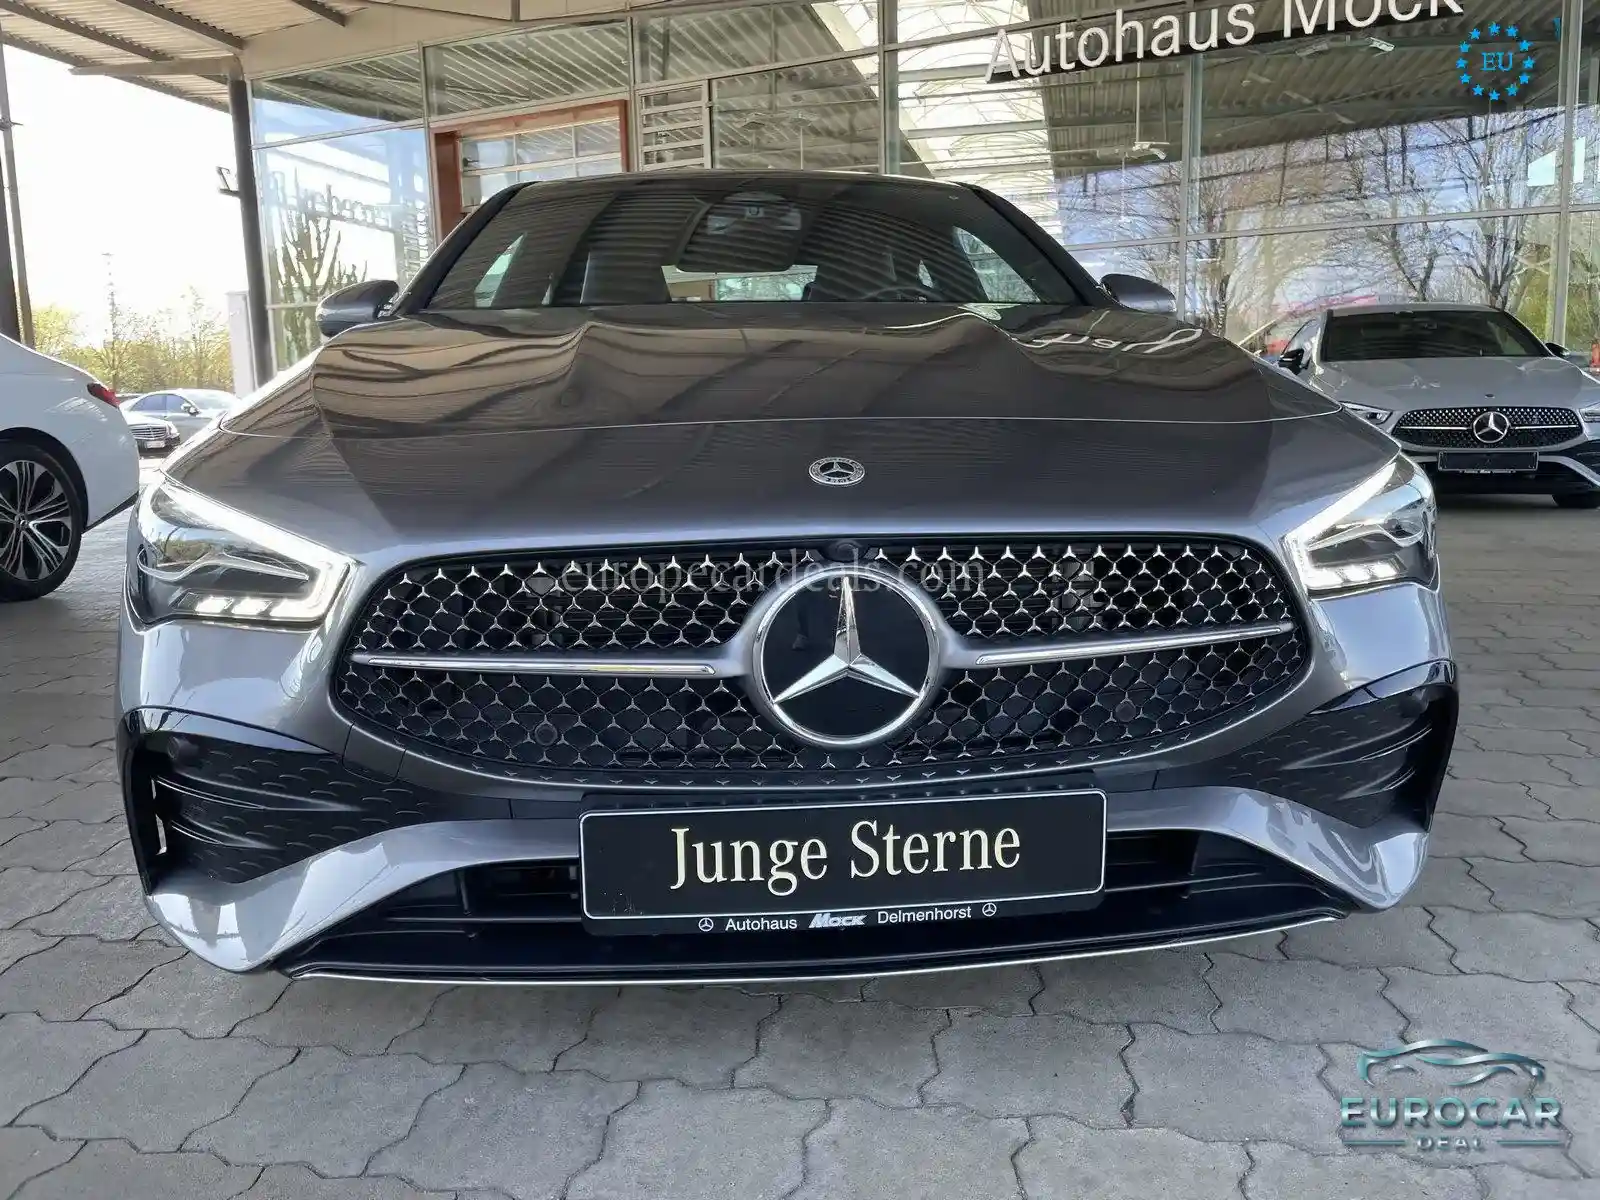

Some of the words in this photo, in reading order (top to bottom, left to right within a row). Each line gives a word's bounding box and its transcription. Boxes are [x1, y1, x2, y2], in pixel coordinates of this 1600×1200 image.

[985, 3, 1256, 84] Autohaus
[669, 827, 828, 896] Junge
[850, 820, 1021, 879] Sterne
[725, 918, 798, 932] Autohaus
[877, 906, 972, 924] Delmenhorst
